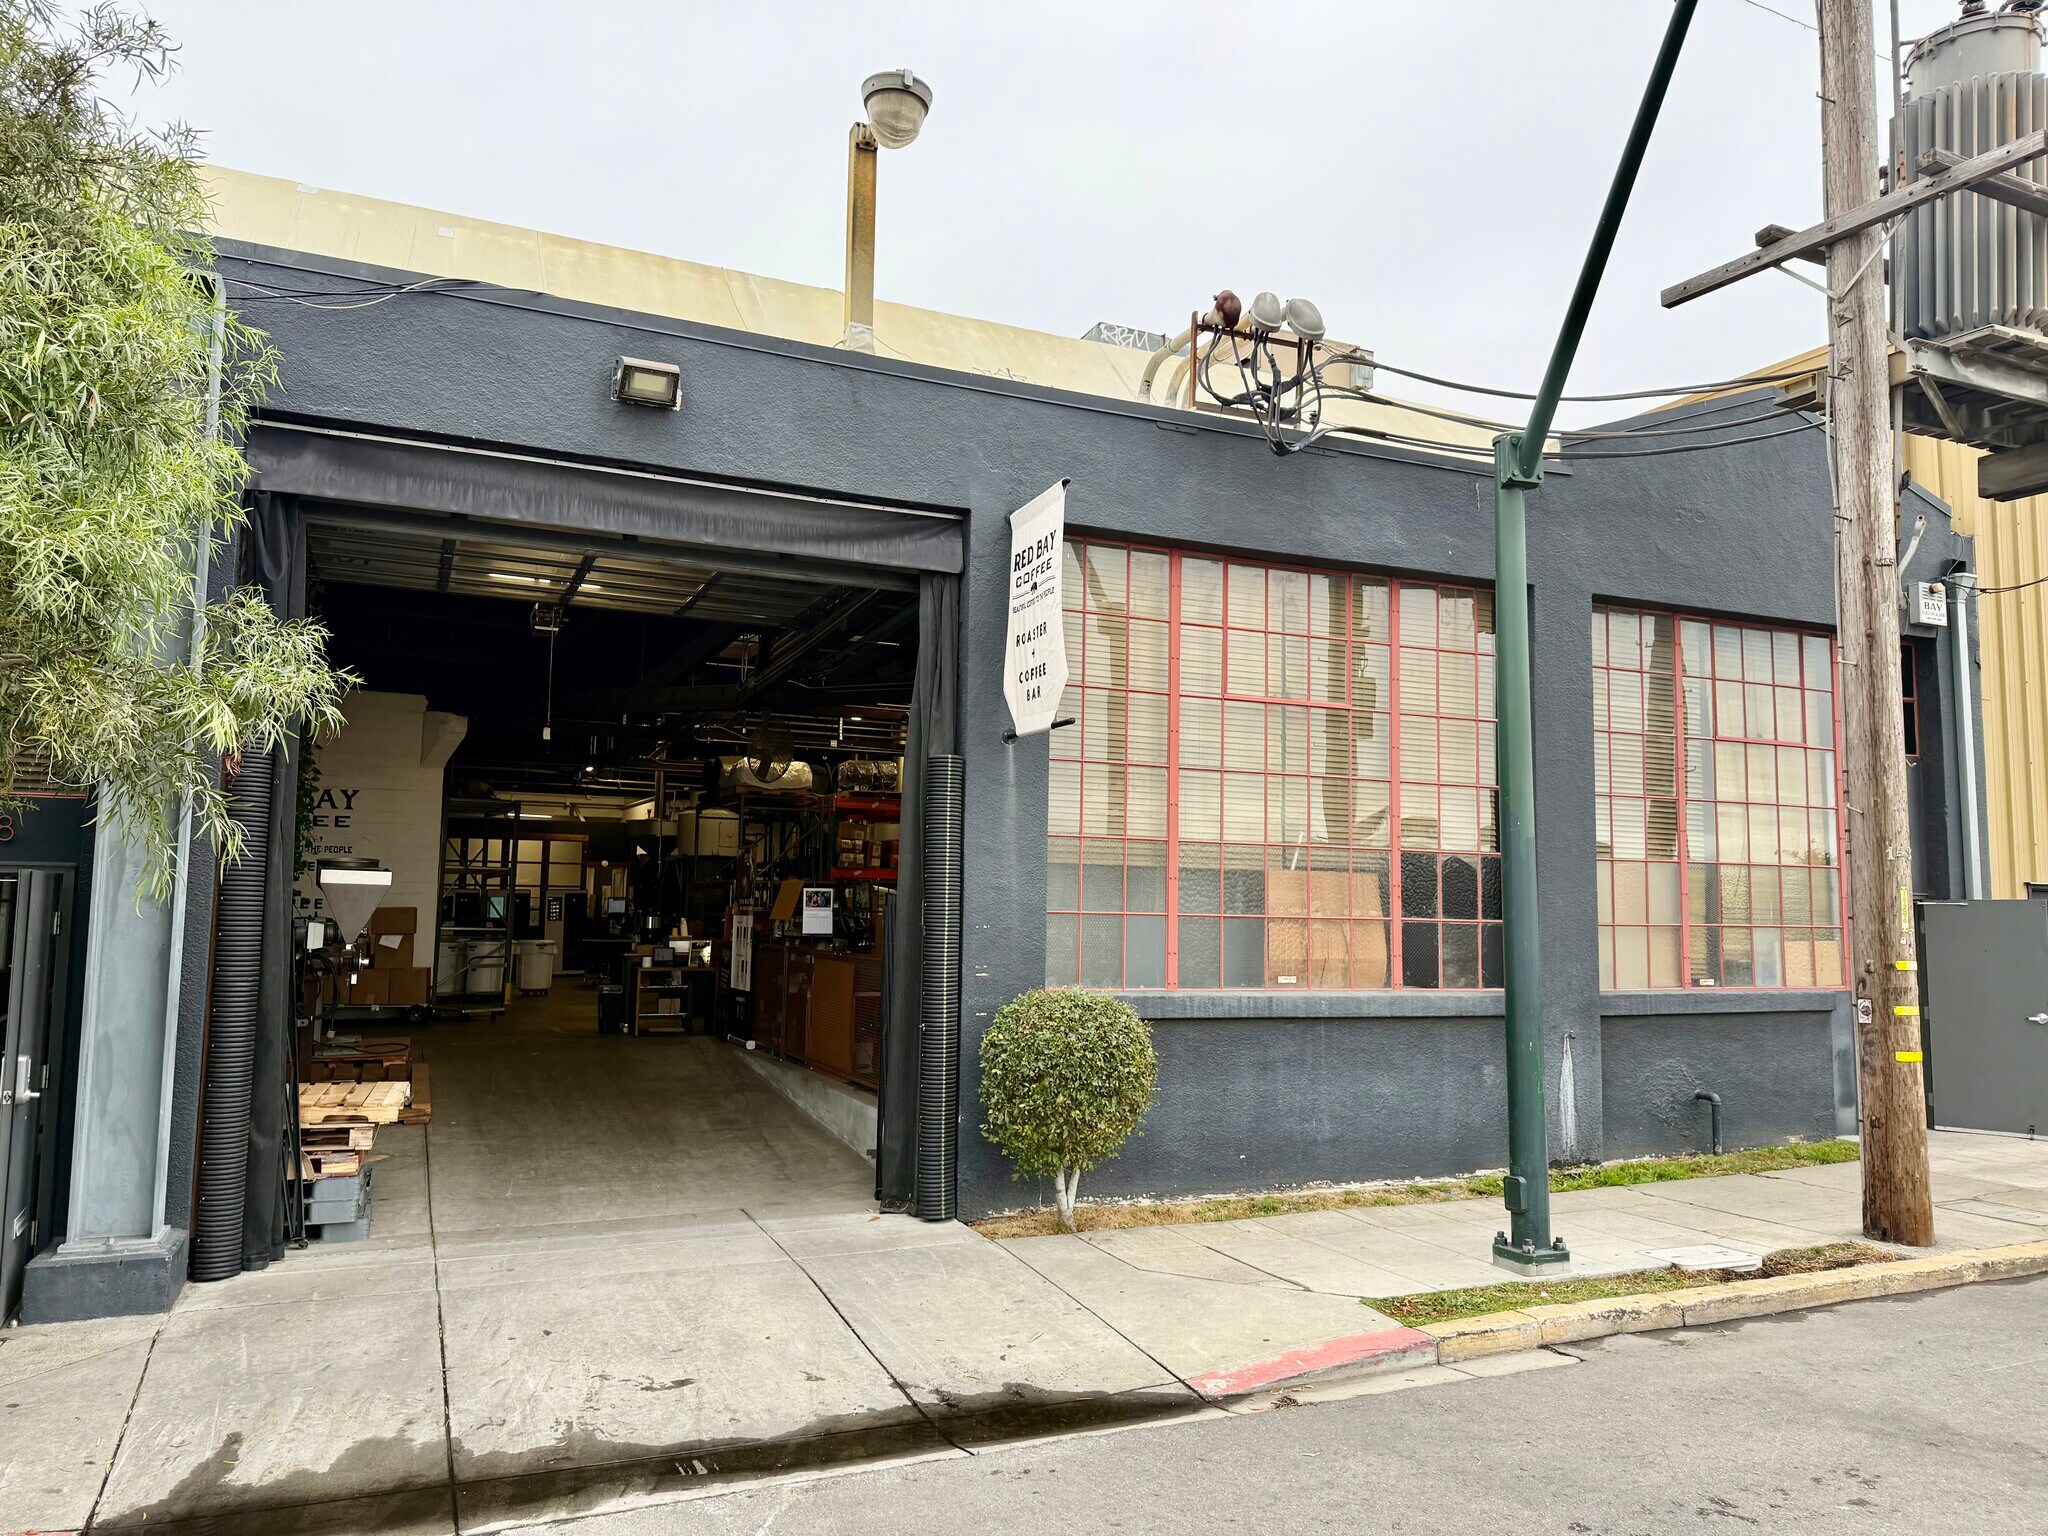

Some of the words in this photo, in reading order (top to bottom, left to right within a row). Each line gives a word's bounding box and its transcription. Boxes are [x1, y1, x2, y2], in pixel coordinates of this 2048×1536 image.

[1014, 545, 1034, 572] RED
[1036, 529, 1057, 560] BAY
[1016, 557, 1052, 588] COFFEE
[1924, 601, 1943, 612] BAY
[1016, 621, 1047, 647] ROASTER
[1018, 662, 1047, 684] COFFEE
[1026, 685, 1041, 701] BAR
[324, 846, 353, 854] PEOPLE
